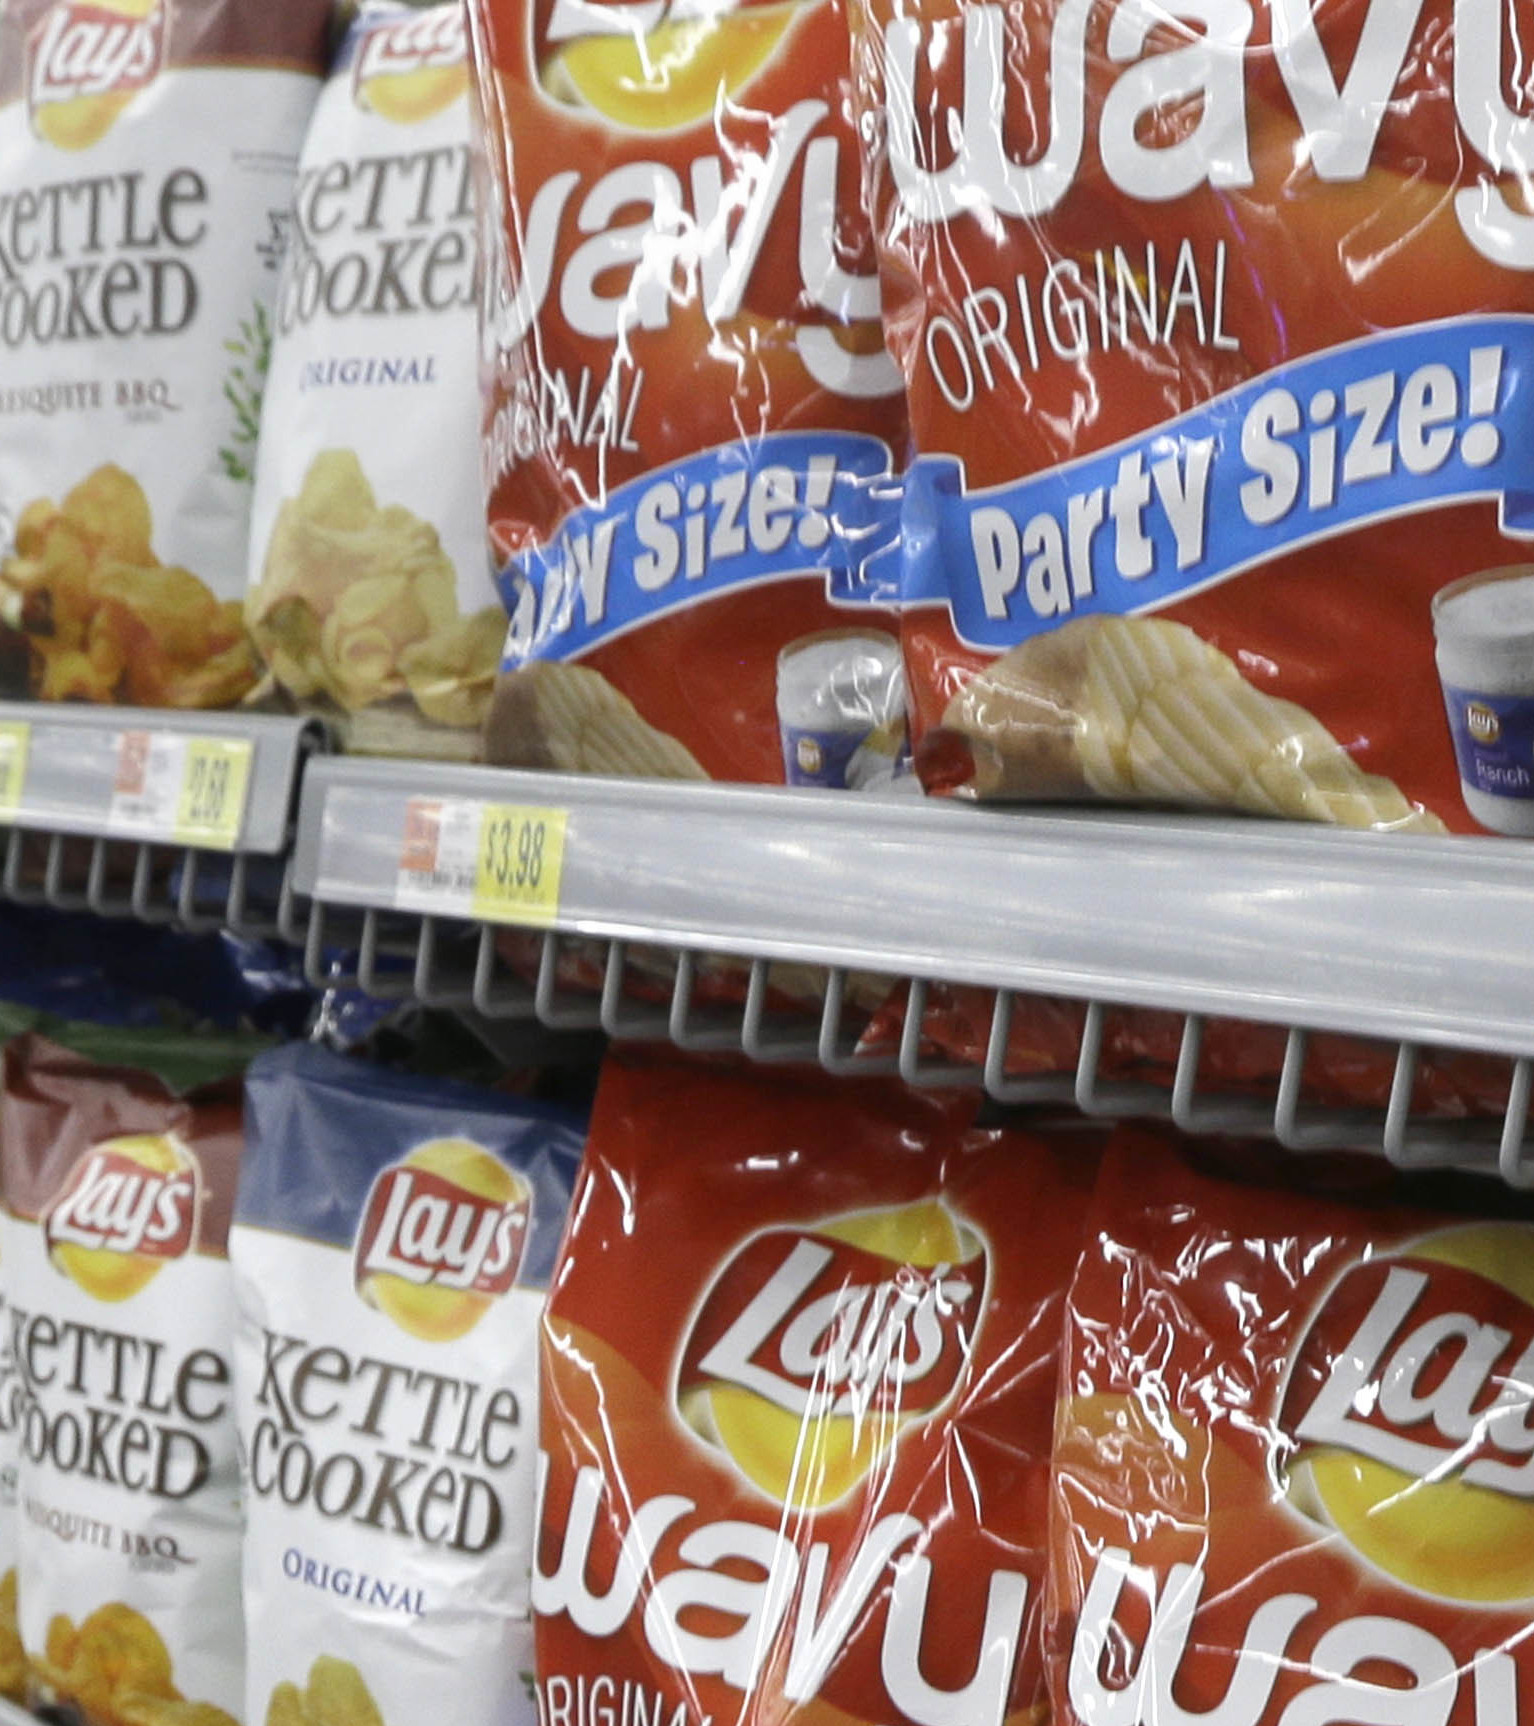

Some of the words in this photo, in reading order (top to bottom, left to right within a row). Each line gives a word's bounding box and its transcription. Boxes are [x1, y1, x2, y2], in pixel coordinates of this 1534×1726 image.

[924, 239, 1241, 413] ORIGINAL
[633, 455, 838, 592] Size!
[968, 430, 1222, 621] Party
[1240, 344, 1505, 528] Size!
[485, 821, 545, 888] $3.98
[366, 1171, 525, 1286] Lay's
[281, 1548, 428, 1618] ORIGINAL
